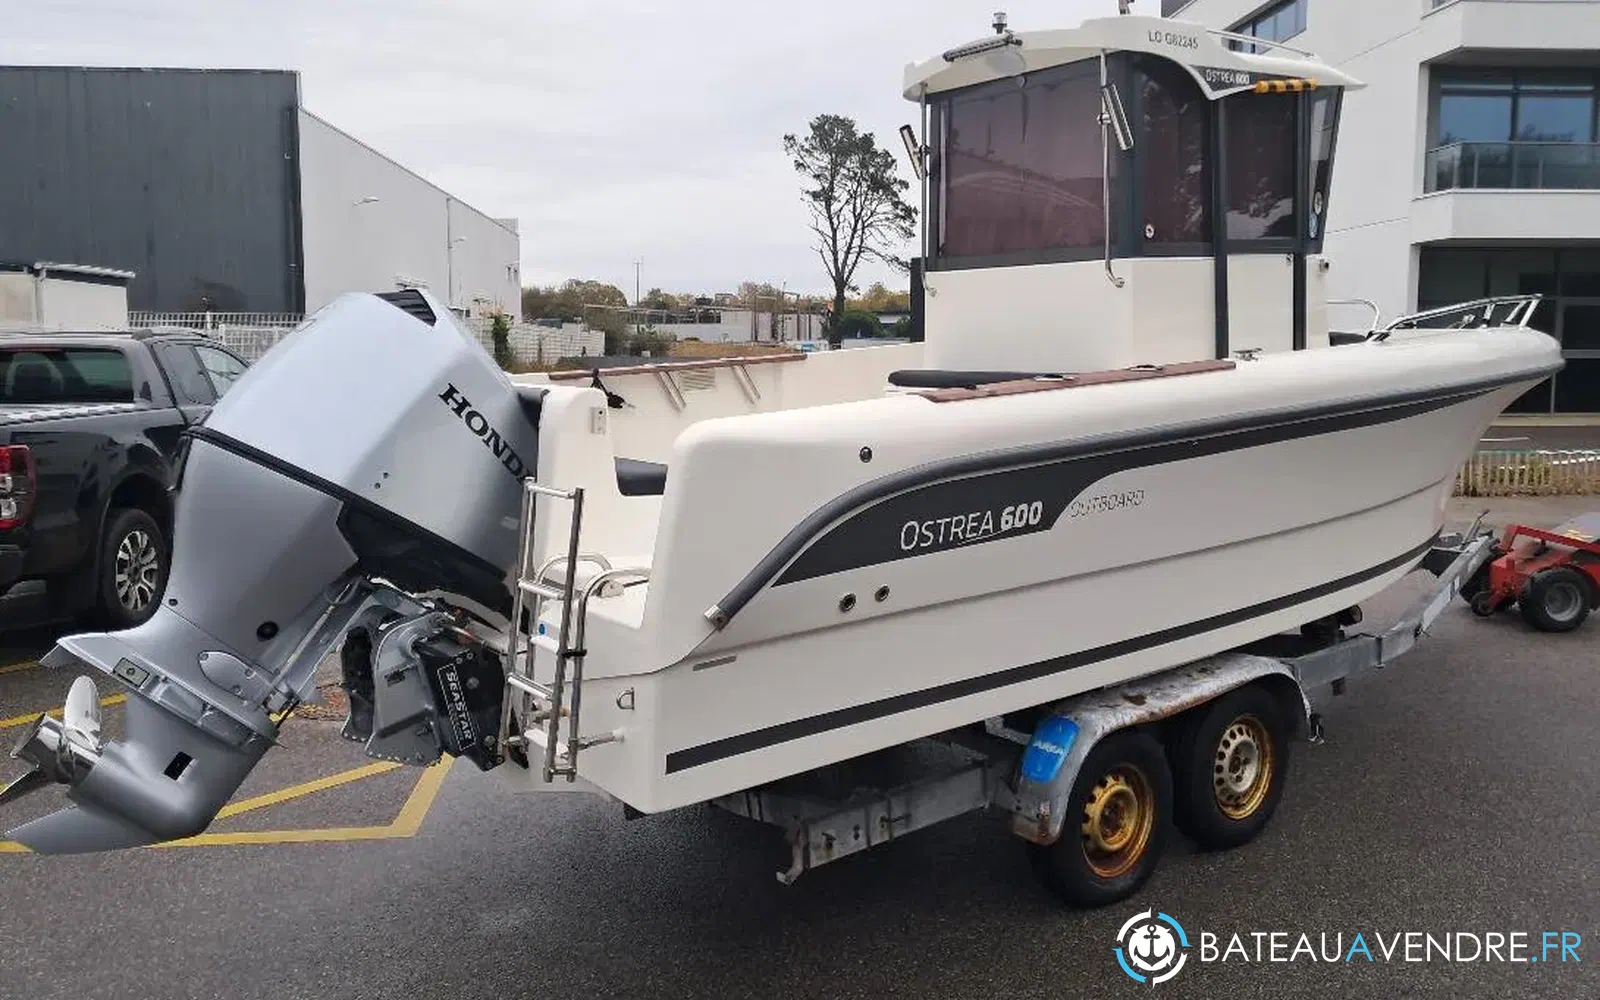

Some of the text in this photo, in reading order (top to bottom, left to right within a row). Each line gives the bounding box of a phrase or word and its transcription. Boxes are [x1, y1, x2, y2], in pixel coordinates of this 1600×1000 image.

[1205, 69, 1250, 84] OSTREA 600
[438, 382, 524, 485] HOND
[1071, 489, 1145, 518] OUTBOARD
[900, 500, 1043, 551] OSTREA 600
